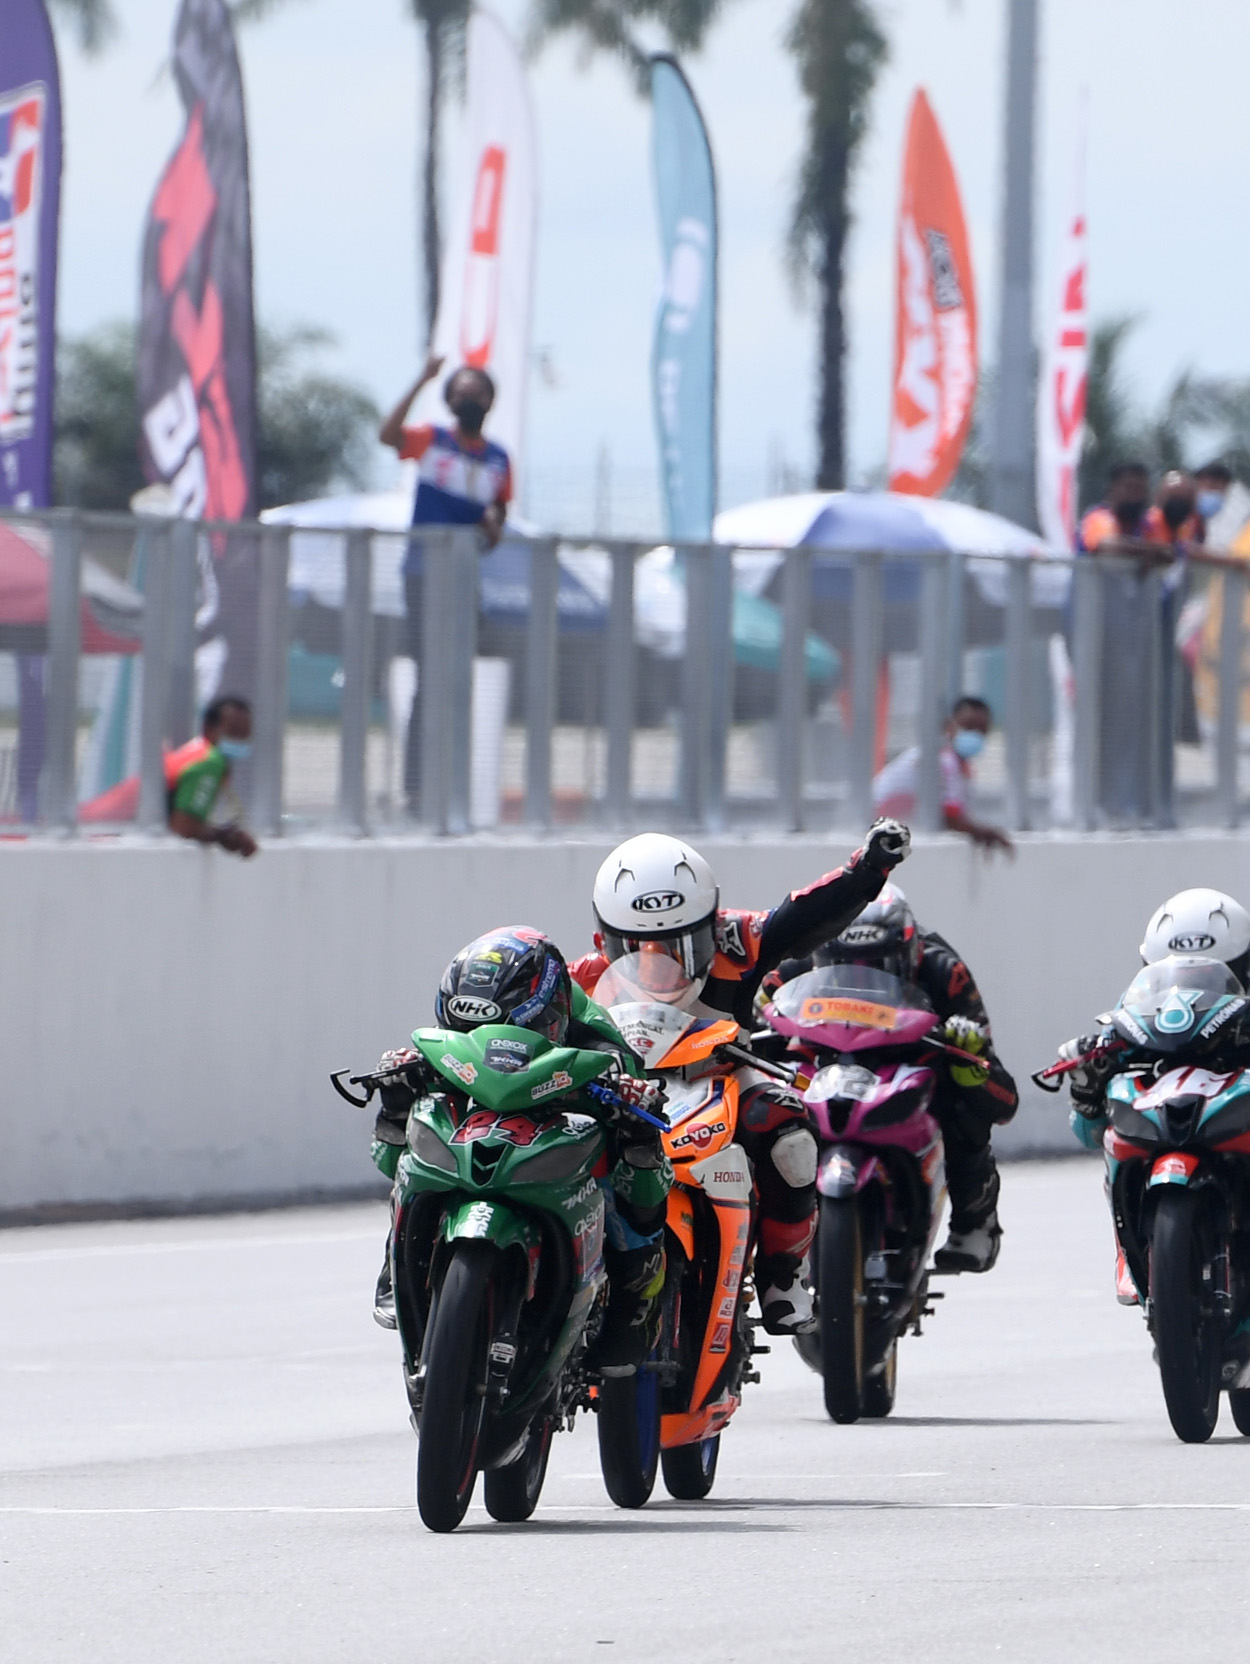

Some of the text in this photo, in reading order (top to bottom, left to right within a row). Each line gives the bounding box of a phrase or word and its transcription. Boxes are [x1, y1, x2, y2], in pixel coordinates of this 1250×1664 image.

[632, 891, 684, 912] KYT
[842, 926, 882, 942] NHK
[1170, 934, 1215, 951] KYT
[451, 999, 494, 1017] NHK
[1200, 998, 1246, 1040] PETRONAS
[447, 1110, 543, 1148] 24
[670, 1122, 726, 1149] KOYOKO
[713, 1171, 745, 1183] HONDA
